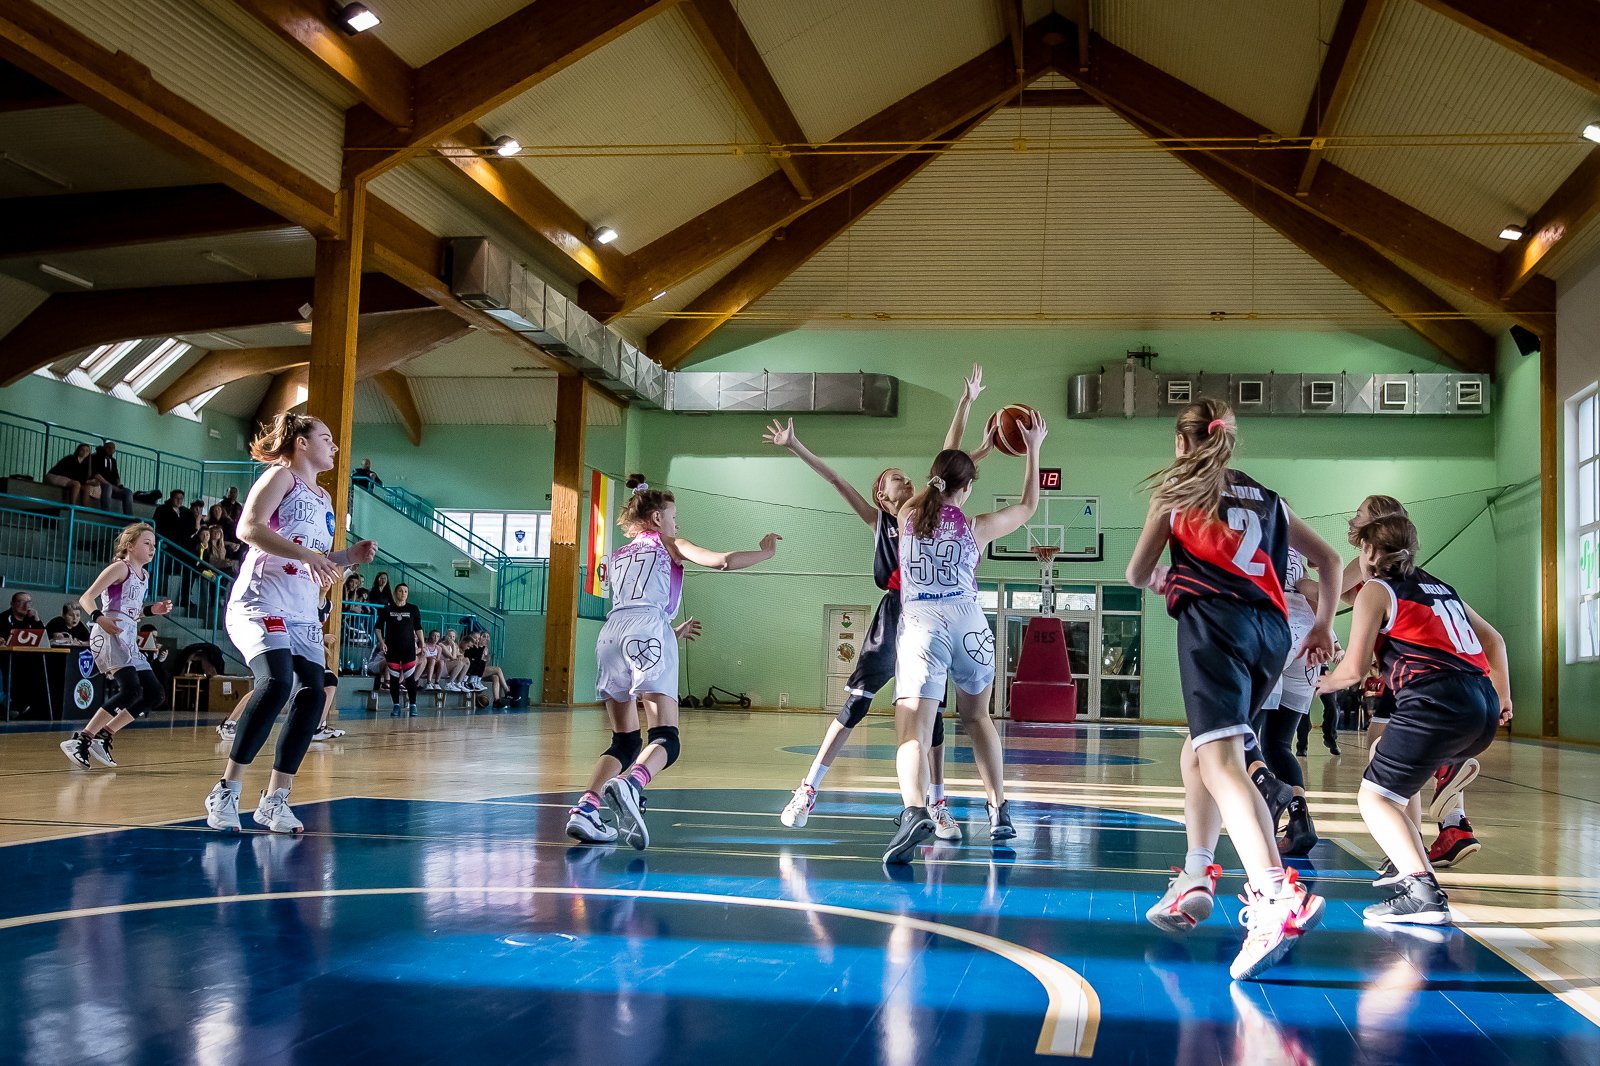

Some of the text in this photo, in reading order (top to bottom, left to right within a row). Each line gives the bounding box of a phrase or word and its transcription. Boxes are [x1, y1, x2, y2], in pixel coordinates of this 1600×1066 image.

[1042, 472, 1059, 487] 18
[293, 499, 315, 525] 82
[1083, 505, 1093, 516] A
[1226, 507, 1266, 577] 2
[614, 550, 657, 606] 77
[909, 538, 962, 587] 53
[17, 630, 38, 646] 5
[1430, 598, 1484, 656] 18
